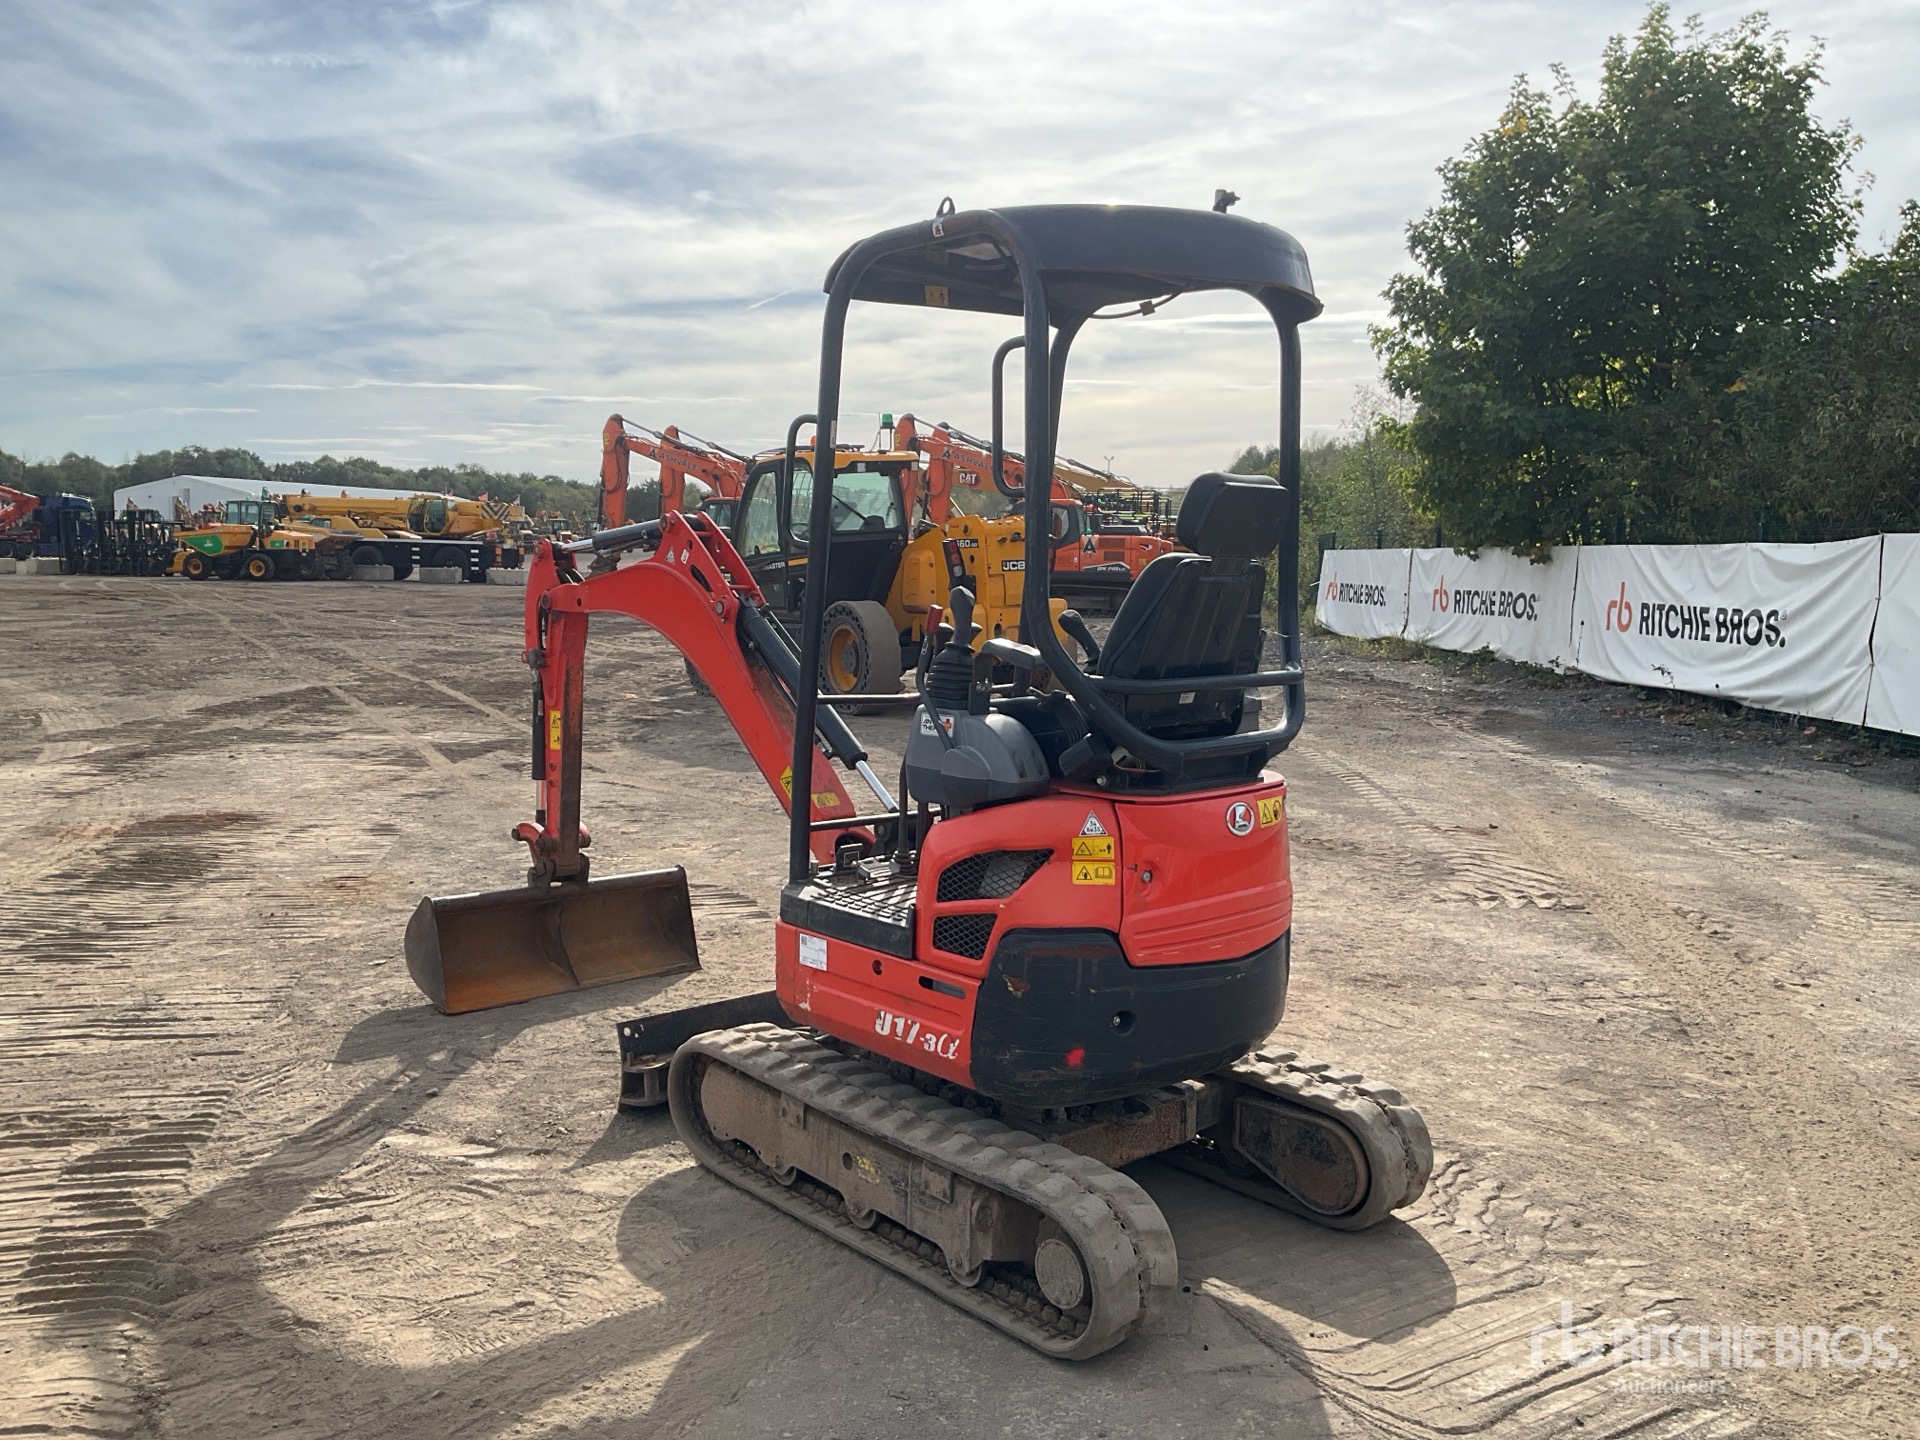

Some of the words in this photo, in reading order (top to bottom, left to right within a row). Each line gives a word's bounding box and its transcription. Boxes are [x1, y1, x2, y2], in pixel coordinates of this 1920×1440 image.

[660, 452, 698, 470] ASHVALE
[954, 453, 991, 471] ASHVAL
[959, 472, 977, 485] CAT
[1002, 561, 1025, 571] JCB
[1339, 582, 1363, 604] RITCHIE
[1453, 589, 1496, 616] RITCHIE
[1639, 602, 1710, 642] RITCHIE
